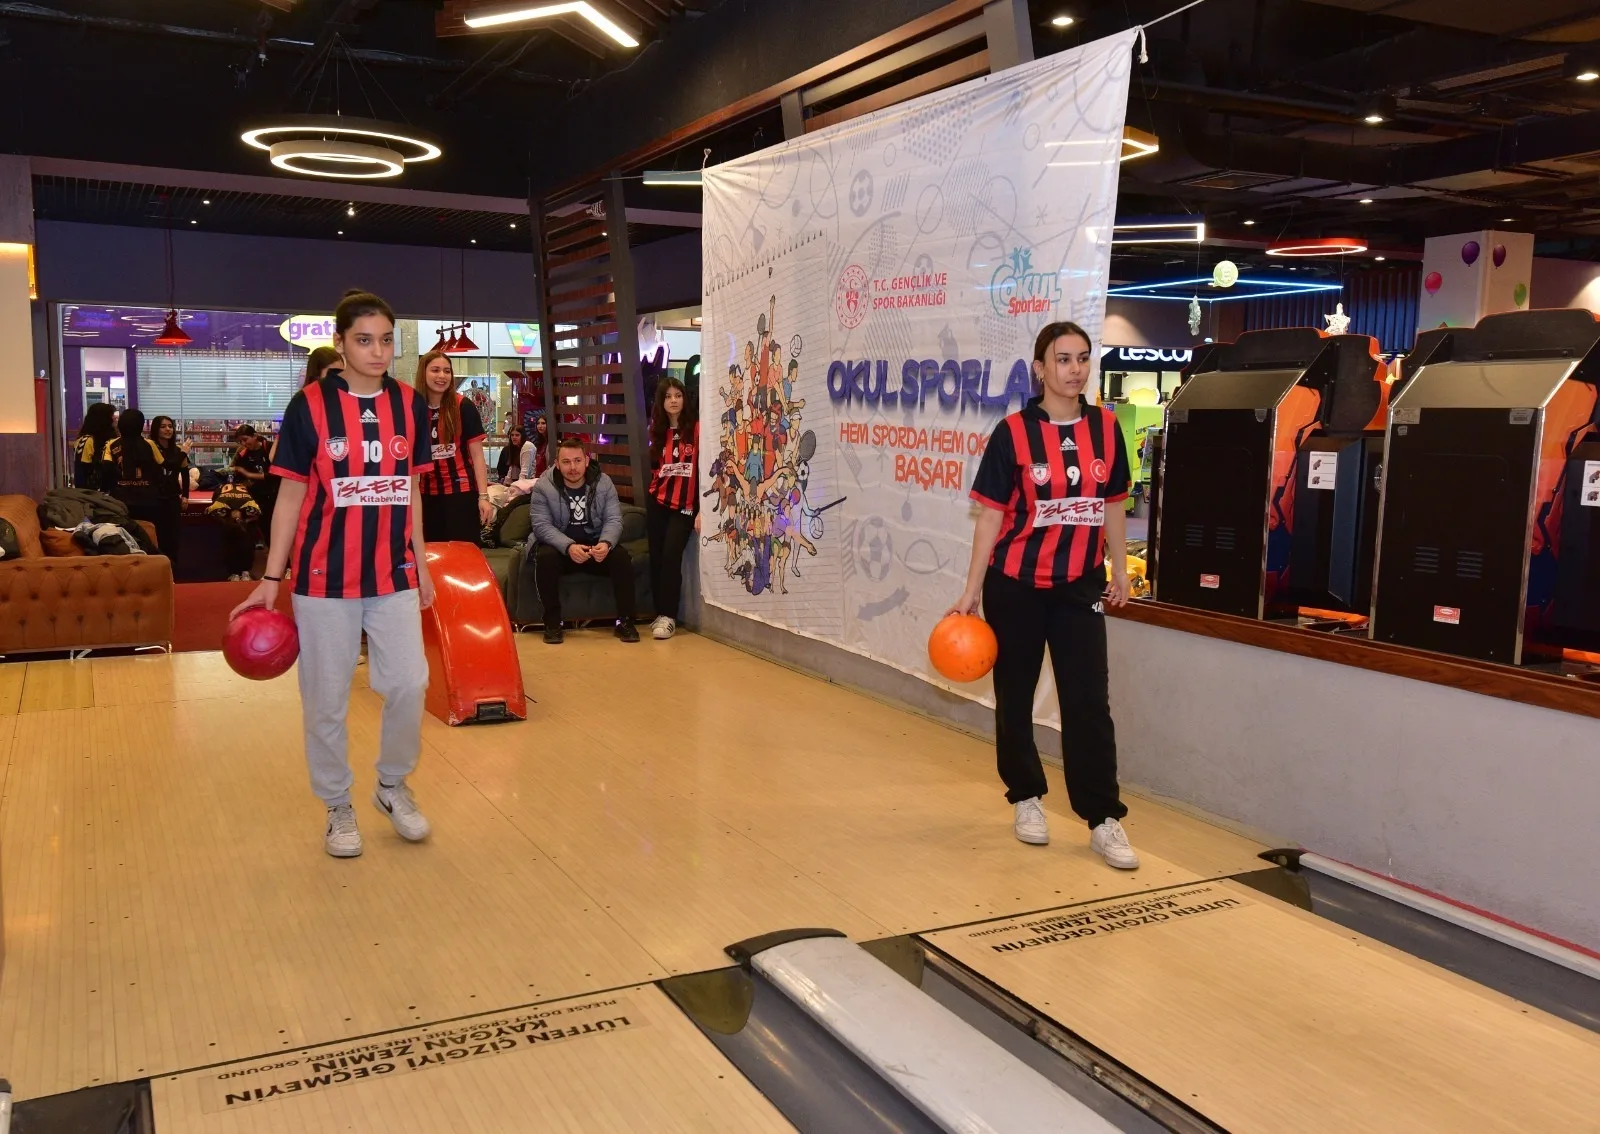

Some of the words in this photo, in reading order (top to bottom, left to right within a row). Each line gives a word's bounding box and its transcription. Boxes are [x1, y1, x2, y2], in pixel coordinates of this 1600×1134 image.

[872, 279, 889, 291] T.C.
[891, 273, 931, 293] GENÇLİK
[935, 272, 947, 286] VE
[1000, 272, 1062, 303] OKUL
[872, 296, 896, 310] SPOR
[897, 291, 946, 308] BAKANLIĞI
[827, 359, 898, 403] OKUL
[900, 358, 1040, 408] SPORLA
[431, 426, 438, 439] 6
[840, 422, 869, 445] HEM
[872, 424, 928, 450] SPORDA
[931, 429, 965, 455] HEM
[967, 432, 991, 456] OK
[361, 440, 383, 463] 10
[672, 446, 679, 457] 4
[894, 454, 963, 491] BAŞARI
[1066, 465, 1081, 486] 9
[1097, 900, 1179, 921] KAYGAN
[1170, 899, 1241, 916] LÜTFEN
[968, 925, 1019, 938] GROUND
[1029, 916, 1097, 934] ZEMİN
[991, 928, 1097, 953] GEÇMEYİN
[567, 1000, 617, 1014] PLEASE
[424, 1019, 548, 1051] KAYGAN
[425, 1029, 457, 1041] THE
[460, 1019, 509, 1033] CROSS
[526, 1016, 632, 1045] LÜTFEN
[390, 1036, 420, 1048] LINE
[305, 1044, 380, 1063] SLIPPERY
[312, 1044, 416, 1073] ZEMİN
[407, 1036, 517, 1071] ÇİZGİYİ
[217, 1060, 300, 1080] GROUND
[225, 1062, 396, 1105] GEÇMEYİN
